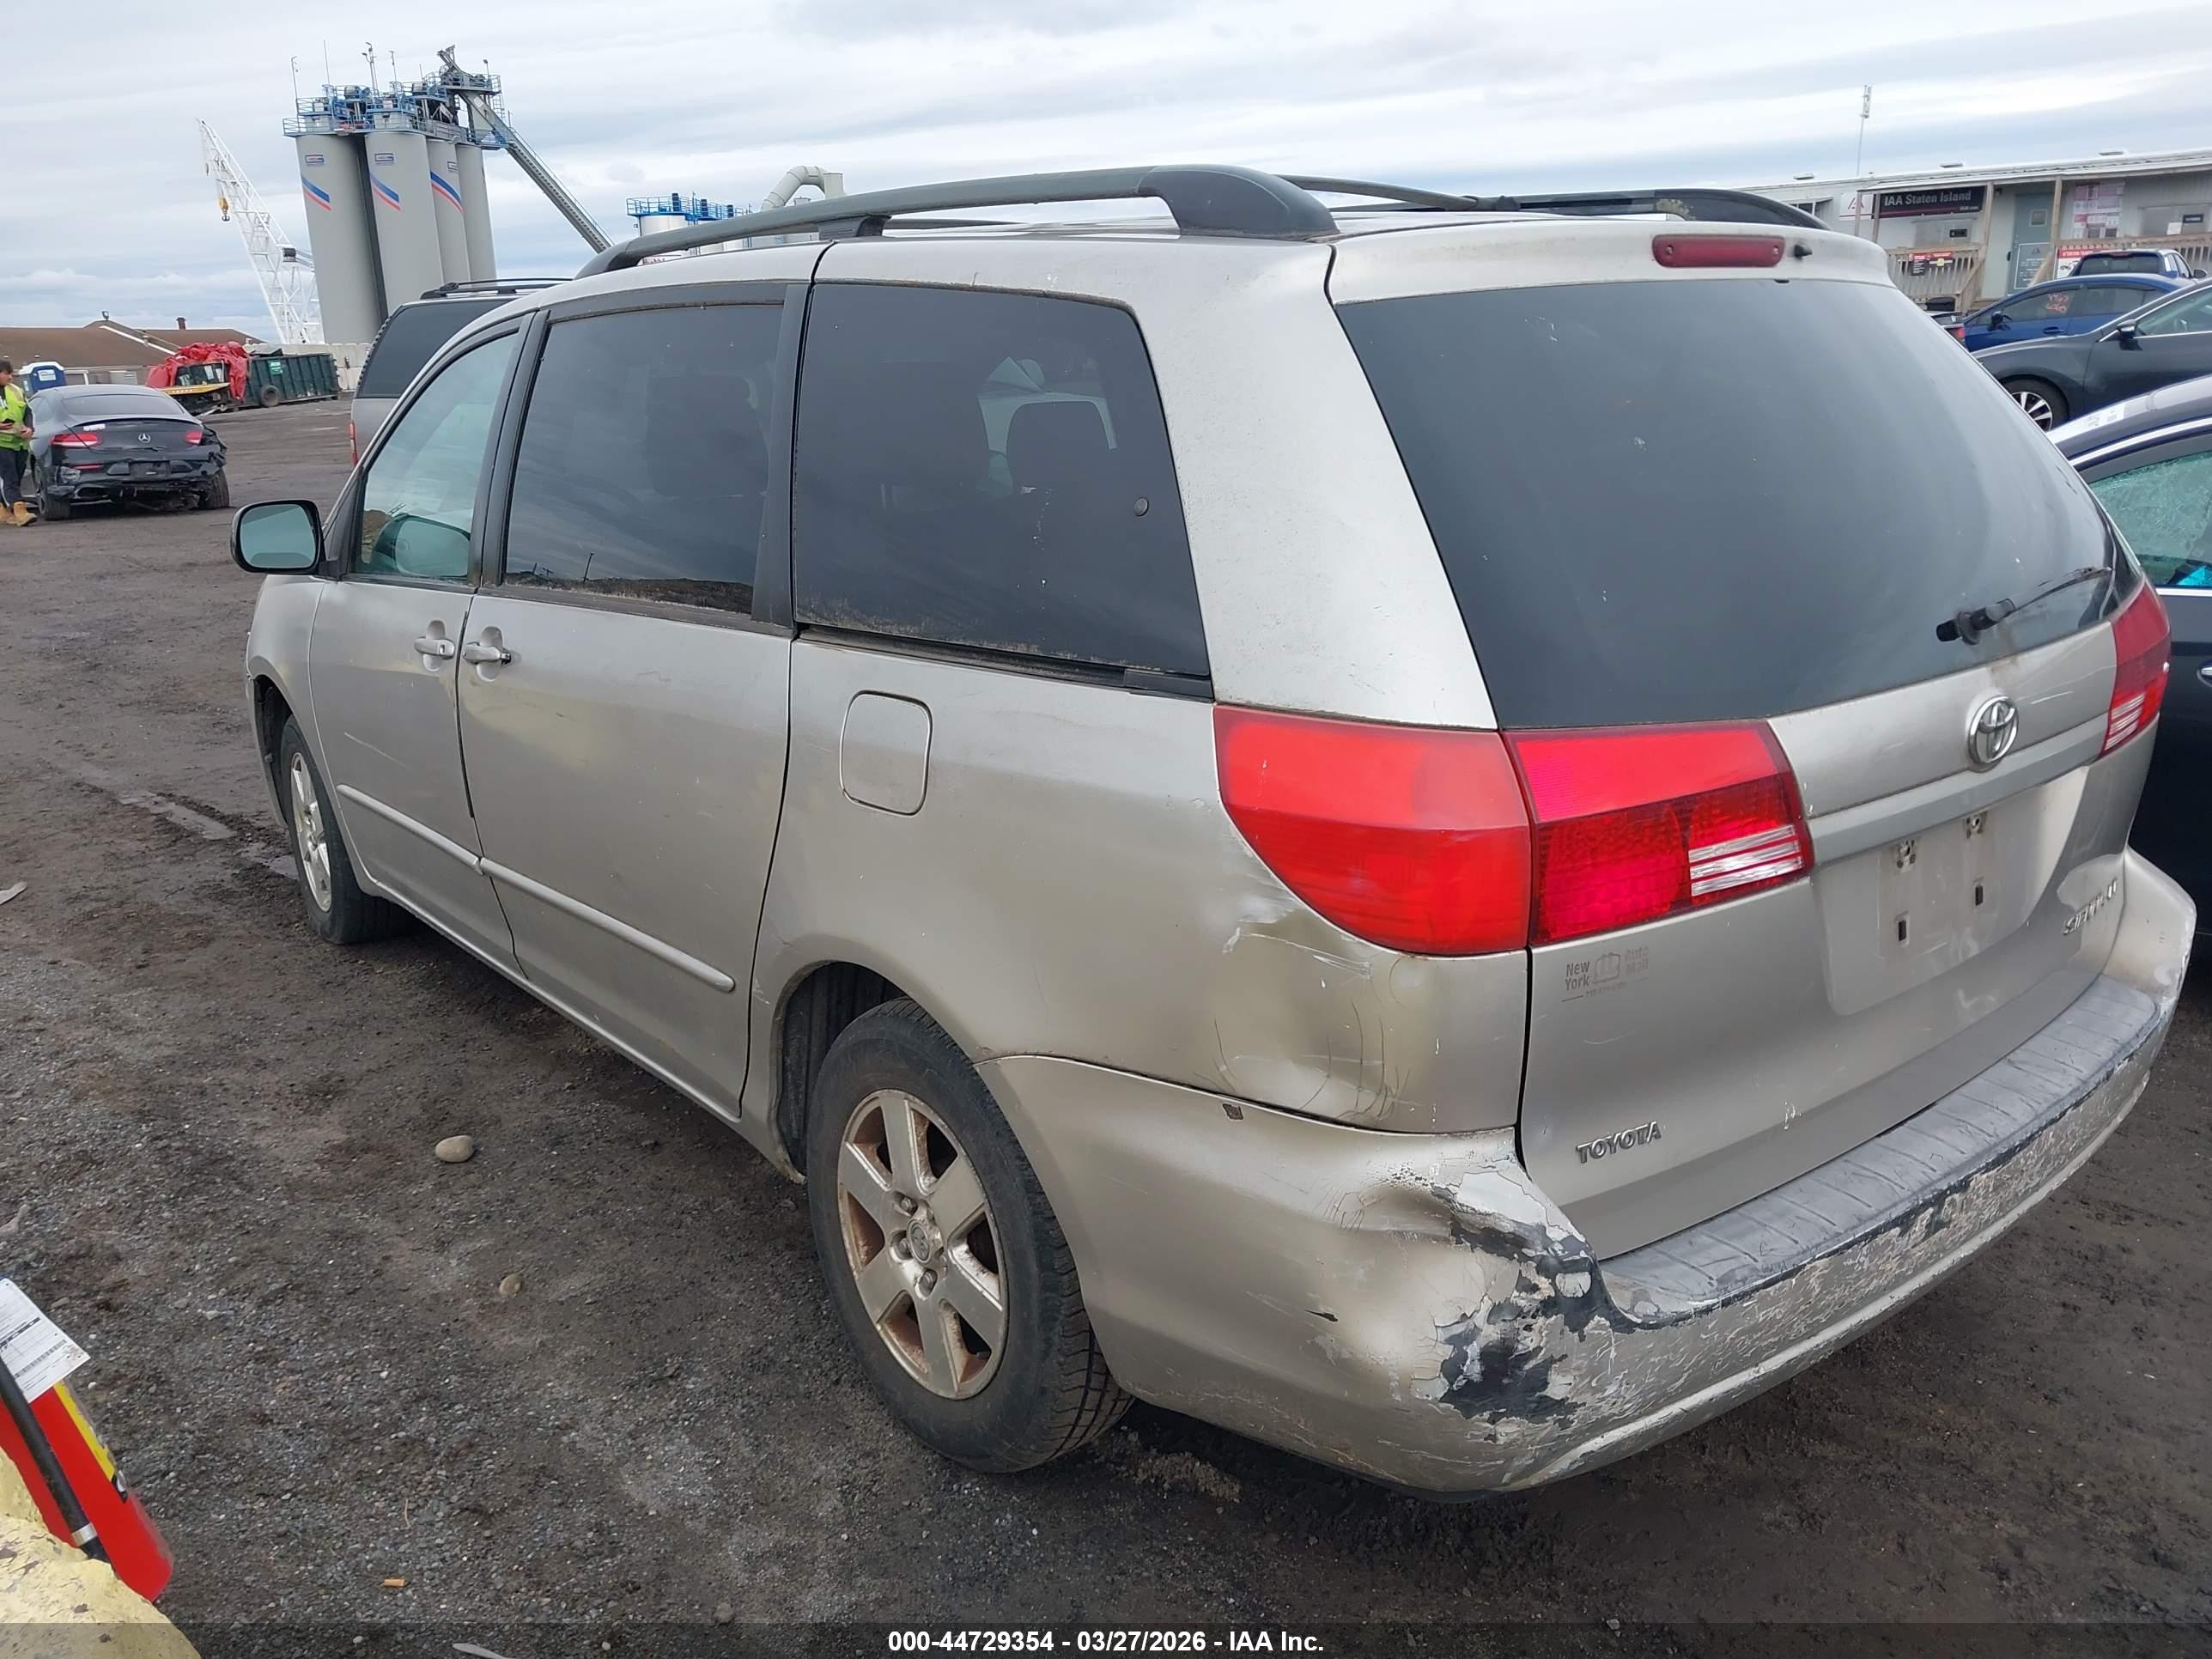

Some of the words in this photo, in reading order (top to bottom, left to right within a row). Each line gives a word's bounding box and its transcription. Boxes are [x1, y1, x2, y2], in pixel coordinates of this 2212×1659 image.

[1884, 195, 1903, 206] IAA
[1905, 193, 1937, 205] Staten
[1940, 190, 1972, 203] Island
[1565, 961, 1589, 977] New
[1565, 974, 1589, 991] York
[1576, 1121, 1662, 1164] TOYOTA
